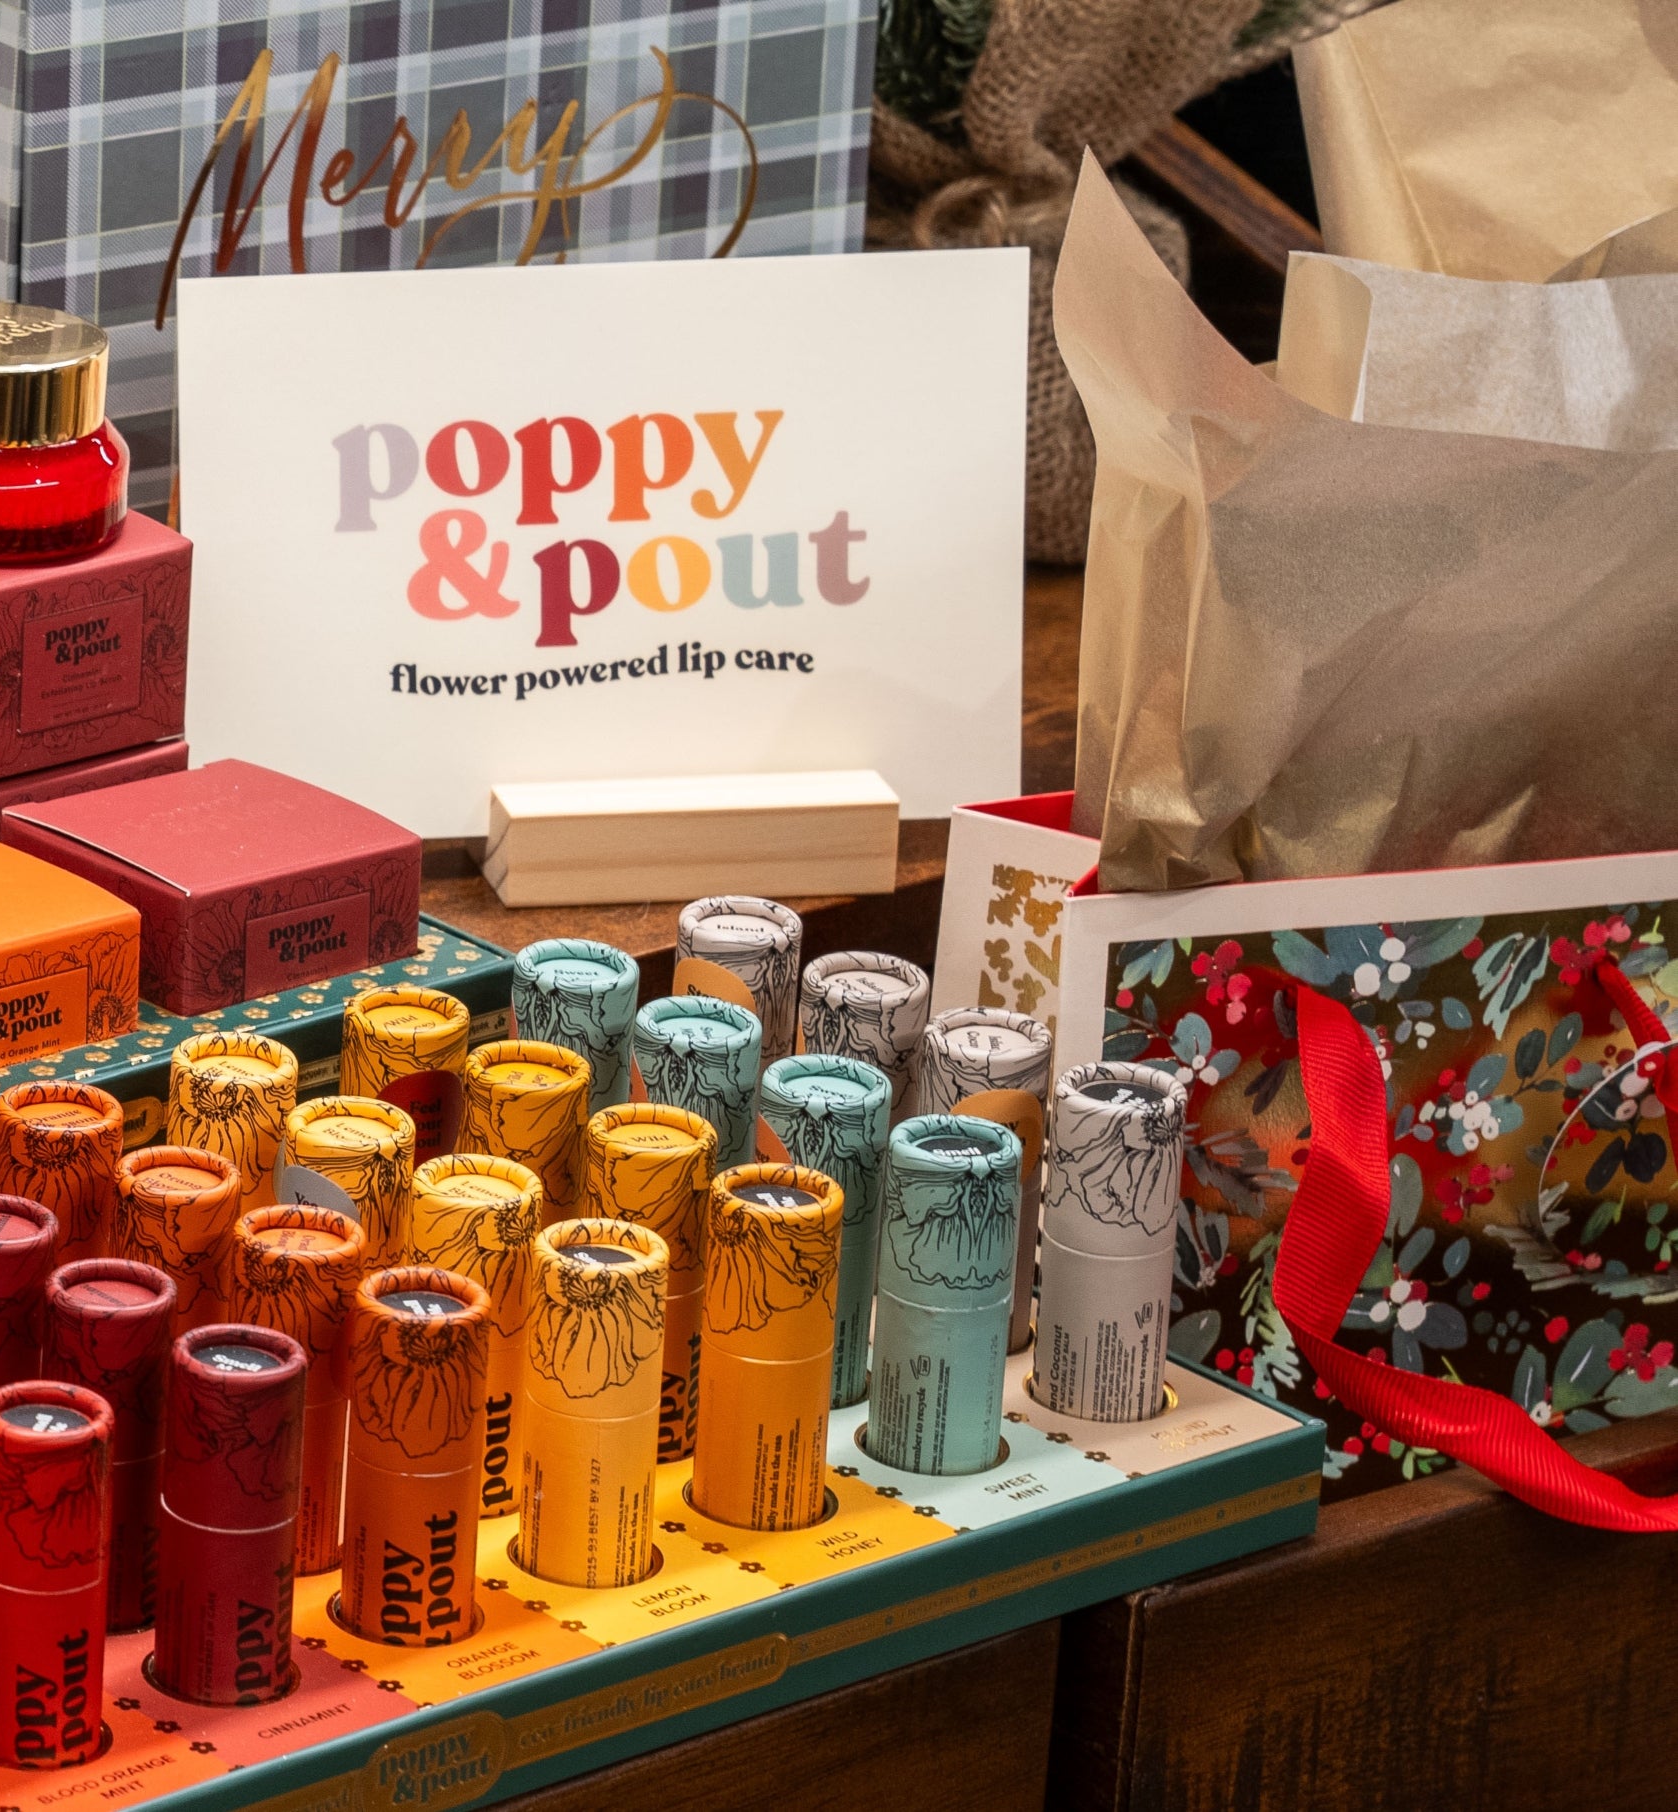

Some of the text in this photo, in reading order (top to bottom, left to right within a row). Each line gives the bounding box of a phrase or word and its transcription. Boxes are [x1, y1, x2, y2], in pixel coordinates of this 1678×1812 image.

[157, 45, 759, 332] Merry
[332, 409, 784, 532] poppy
[45, 617, 110, 651] poppy
[390, 642, 815, 701] flower powered lip care
[268, 914, 335, 949] poppy
[8, 1044, 39, 1058] Orange
[42, 1038, 60, 1049] Mint
[416, 1118, 441, 1131] our
[416, 1132, 440, 1148] oul
[629, 1132, 671, 1145] Wild
[1050, 1324, 1063, 1380] Coconut
[1059, 1332, 1070, 1403] NATURAL LIP BALM
[1139, 1334, 1149, 1367] recycle
[914, 1387, 927, 1433] to recycle
[480, 1391, 513, 1518] pout
[768, 1434, 783, 1509] made in the usa
[587, 1458, 601, 1534] BEST BY 3/27
[984, 1473, 1038, 1494] SWEET
[1008, 1484, 1050, 1502] MINT
[630, 1511, 638, 1528] the
[628, 1541, 636, 1567] made
[816, 1531, 859, 1548] WILD
[826, 1536, 884, 1560] HONEY
[381, 1538, 425, 1646] ppy
[425, 1509, 461, 1647] pout
[635, 1584, 693, 1608] LEMON
[649, 1594, 711, 1618] BLOOM
[234, 1599, 276, 1706] ppy
[446, 1641, 520, 1669] ORANGE
[458, 1649, 541, 1681] BLOSSOM
[718, 1647, 778, 1682] brand
[14, 1664, 57, 1769] ppy
[257, 1702, 352, 1740] CINNAMINT
[379, 1731, 477, 1786] poppy
[37, 1754, 176, 1805] BLOOD ORANGE
[100, 1780, 146, 1800] MINT
